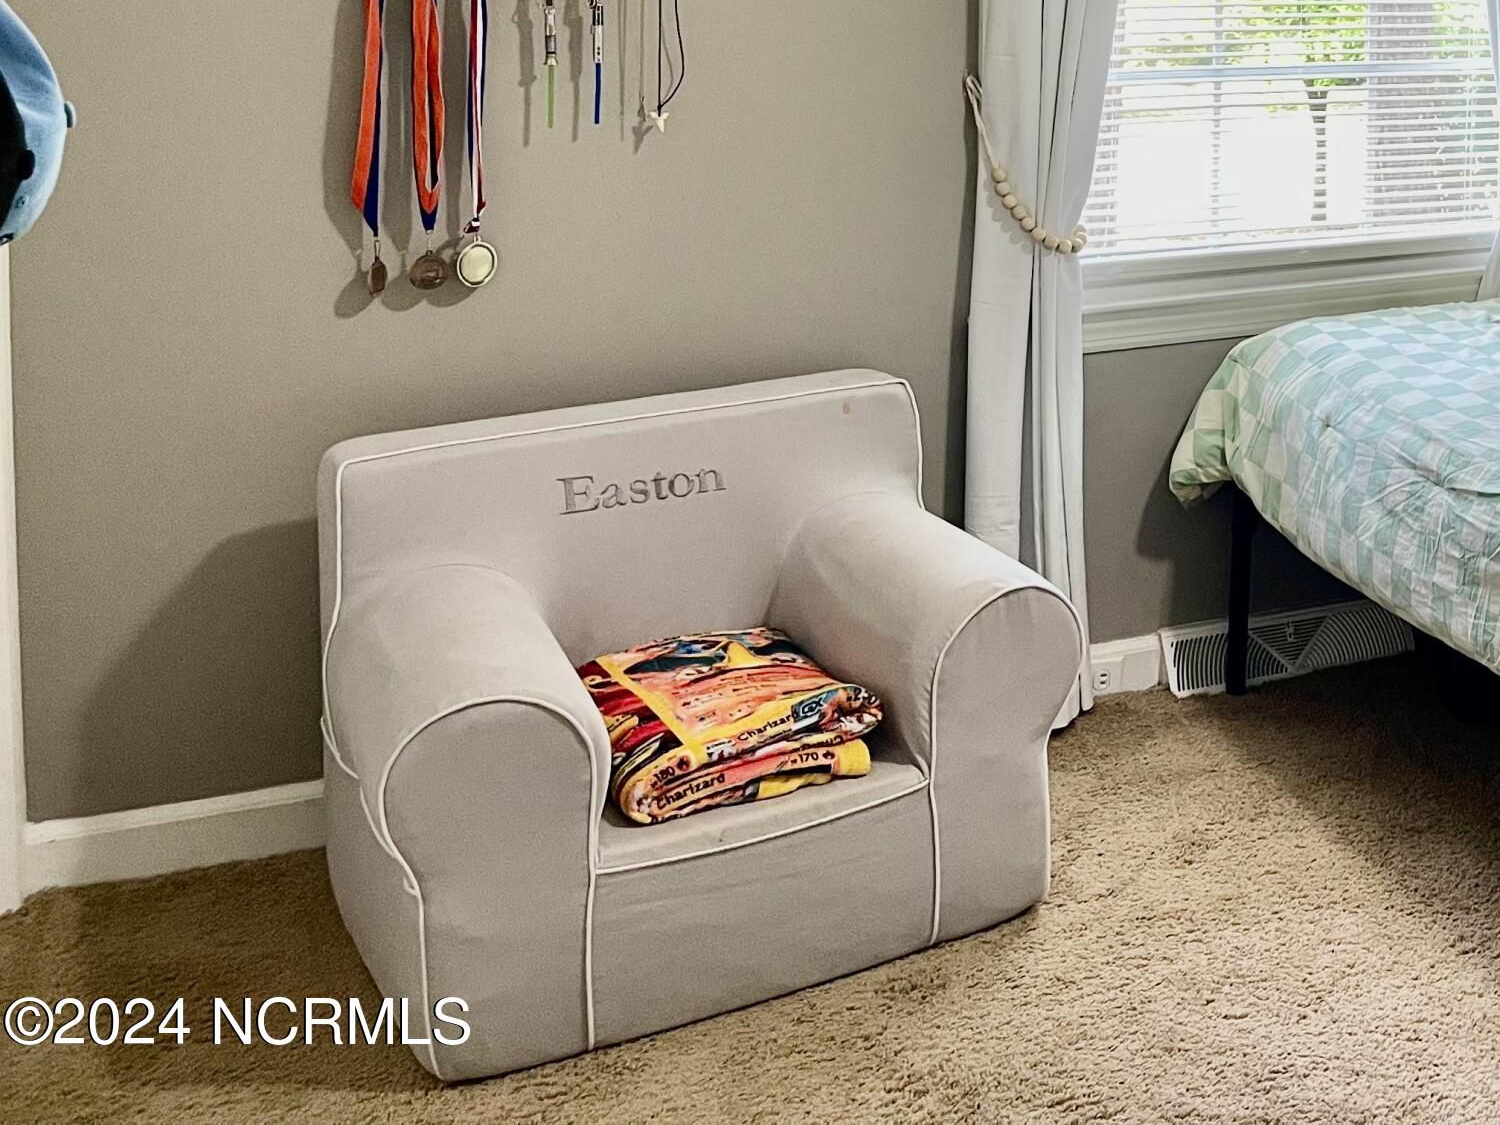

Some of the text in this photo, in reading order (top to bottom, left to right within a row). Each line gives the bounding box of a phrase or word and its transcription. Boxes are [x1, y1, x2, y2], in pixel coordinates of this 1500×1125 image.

[556, 468, 727, 516] Easton
[737, 710, 798, 742] Charizard
[655, 773, 726, 810] Charizard
